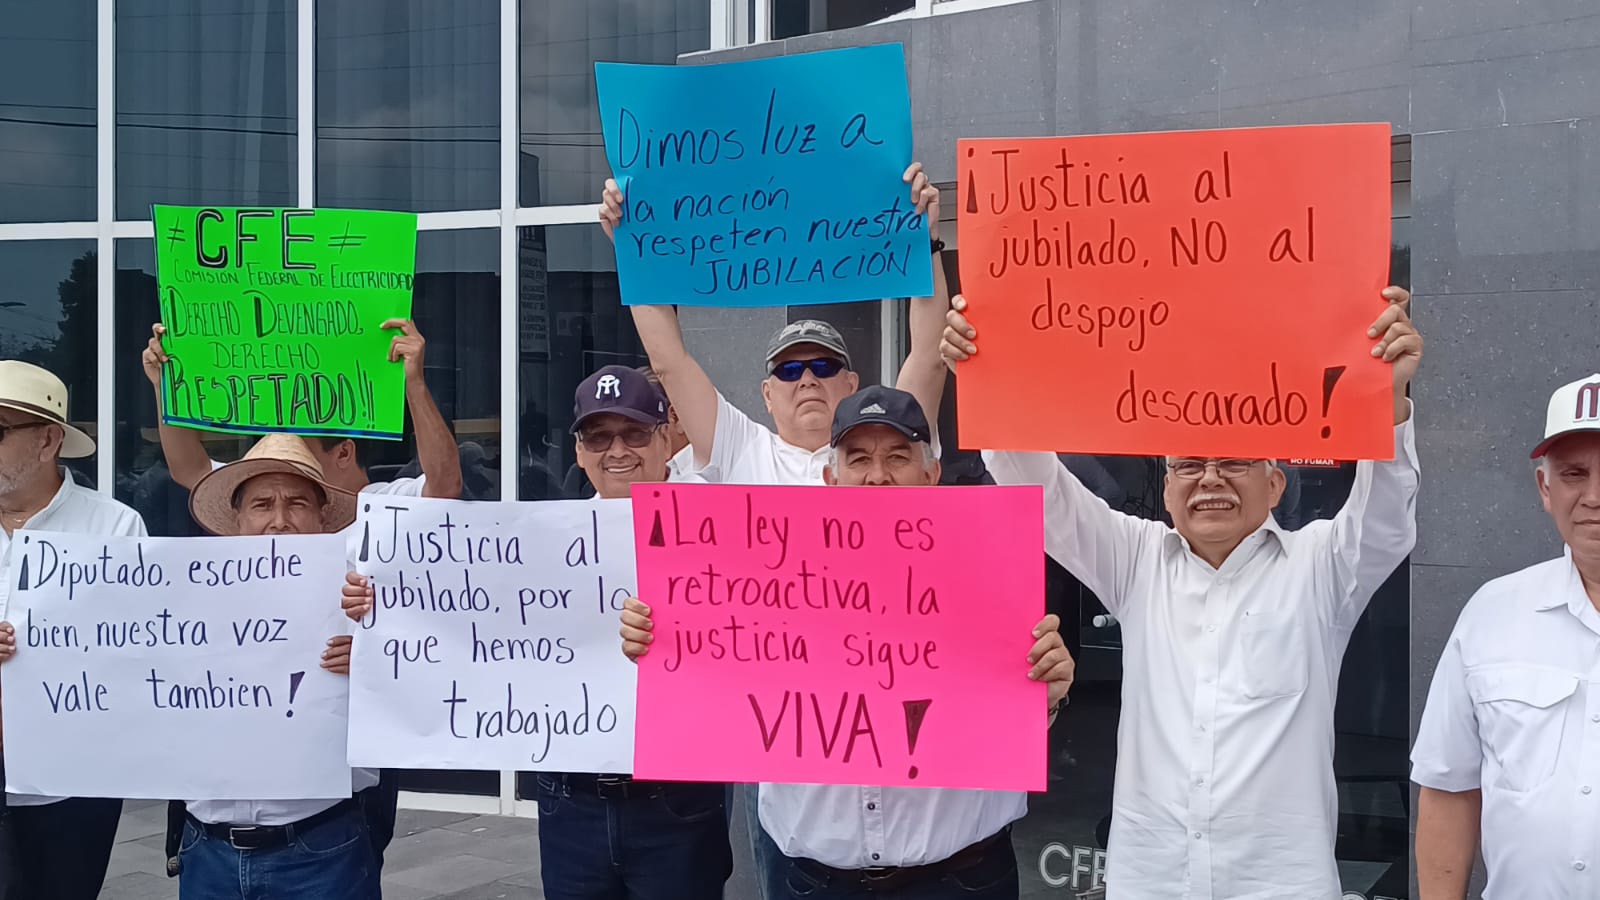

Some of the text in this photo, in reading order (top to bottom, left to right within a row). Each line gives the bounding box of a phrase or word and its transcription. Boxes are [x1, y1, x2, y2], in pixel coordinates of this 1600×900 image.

[618, 86, 886, 172] Dimos luz a
[623, 175, 791, 224] la nación
[965, 146, 1233, 215] ¡Justicia al
[195, 209, 316, 269] CFE
[629, 196, 924, 267] respeten nuestra
[988, 206, 1316, 279] jubilado, NO al
[308, 271, 328, 288] DE
[692, 240, 912, 295] JUBILACIÓN
[242, 289, 364, 338] DEVENGADO,
[1030, 277, 1170, 352] despojo
[207, 341, 320, 370] DERECHO
[358, 503, 601, 569] ¡Justicia al
[647, 489, 936, 571] ¡La ley no es
[187, 538, 304, 588] escuche
[666, 559, 941, 616] retroactiva, la
[26, 607, 290, 654] bien, nuestra voz
[518, 587, 574, 626] por
[382, 621, 576, 681] que hemos
[663, 614, 941, 691] justicia sigue
[41, 670, 110, 715] vale
[442, 679, 618, 764] trabajado
